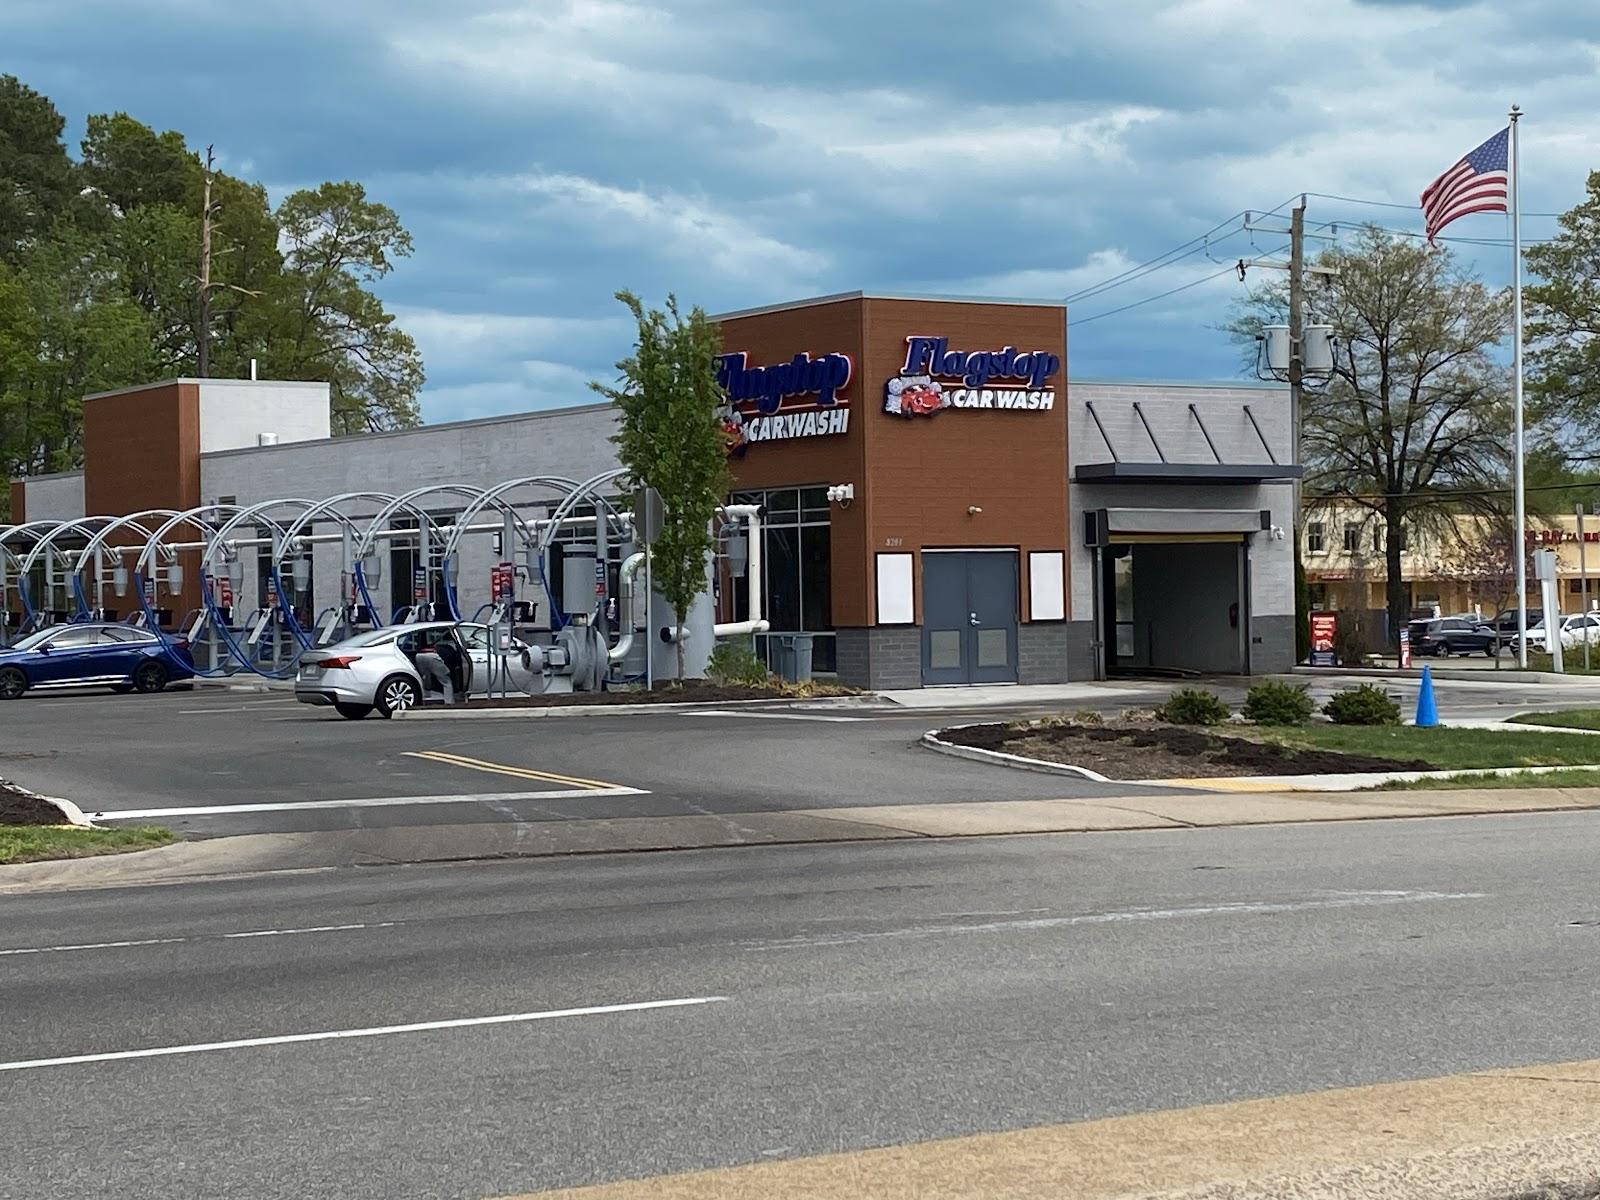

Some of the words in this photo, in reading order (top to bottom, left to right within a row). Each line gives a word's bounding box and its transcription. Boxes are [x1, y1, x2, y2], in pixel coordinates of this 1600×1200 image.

[901, 335, 1060, 389] Flagstop
[953, 390, 993, 408] CAR
[996, 390, 1055, 409] WASH
[749, 415, 785, 441] CAR
